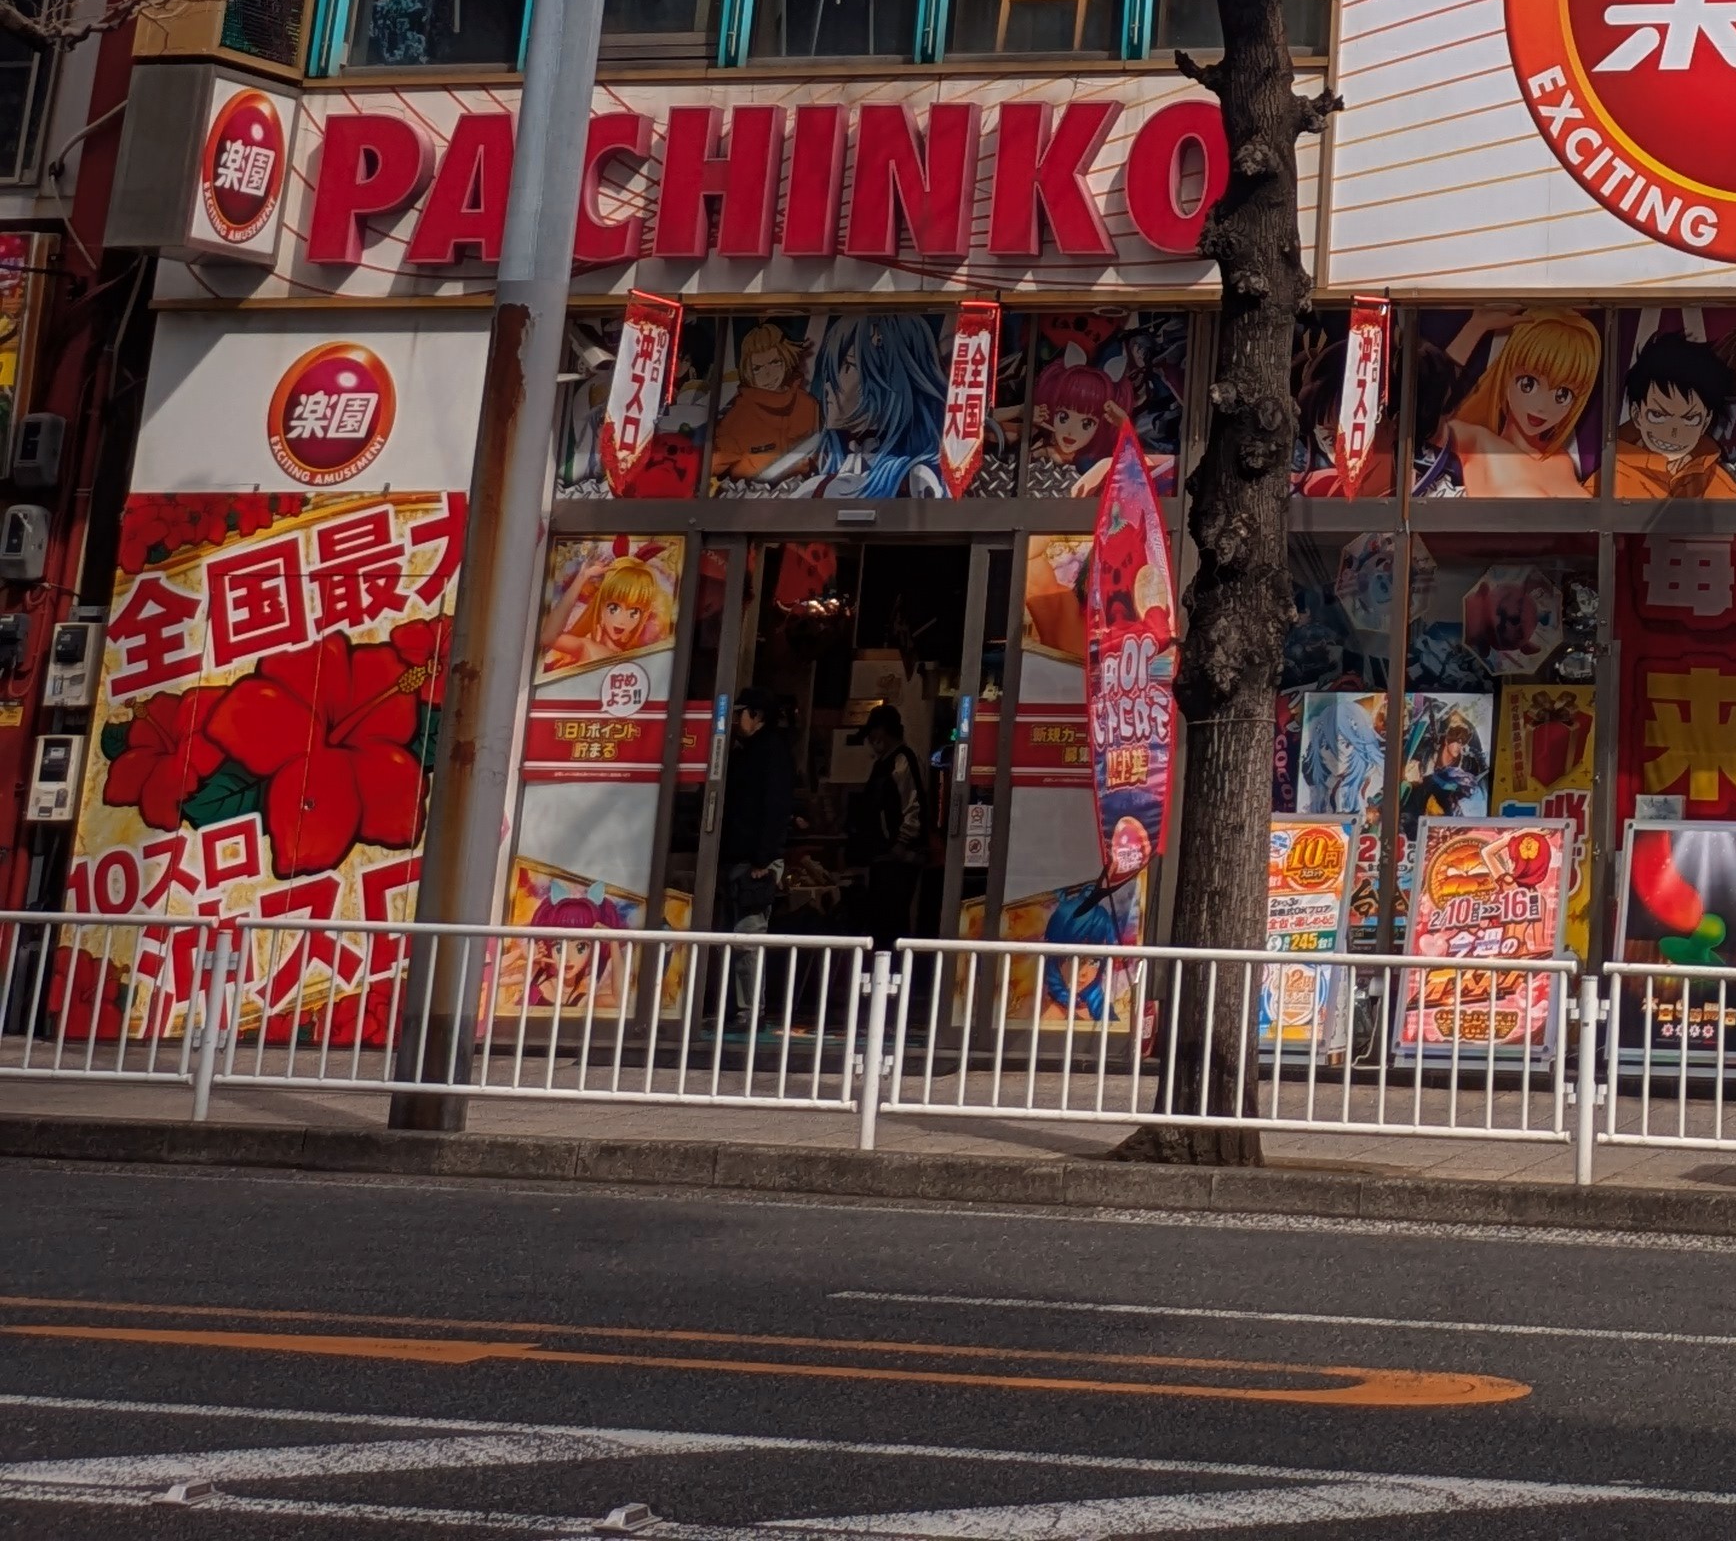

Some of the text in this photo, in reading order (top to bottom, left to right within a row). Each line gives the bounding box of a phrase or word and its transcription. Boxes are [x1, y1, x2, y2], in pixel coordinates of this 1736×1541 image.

[214, 138, 275, 198] 楽園
[306, 99, 1231, 266] PACHINKO
[1528, 65, 1721, 249] EXCITING
[286, 390, 380, 441] 楽園
[618, 327, 656, 455] 沖スロ
[946, 343, 969, 442] 最大
[961, 345, 988, 441] 全国
[269, 433, 387, 487] EXCITING AMUSEMENT
[609, 672, 639, 691] 貯め
[571, 741, 618, 760] 貯まる
[1502, 890, 1528, 919] 16
